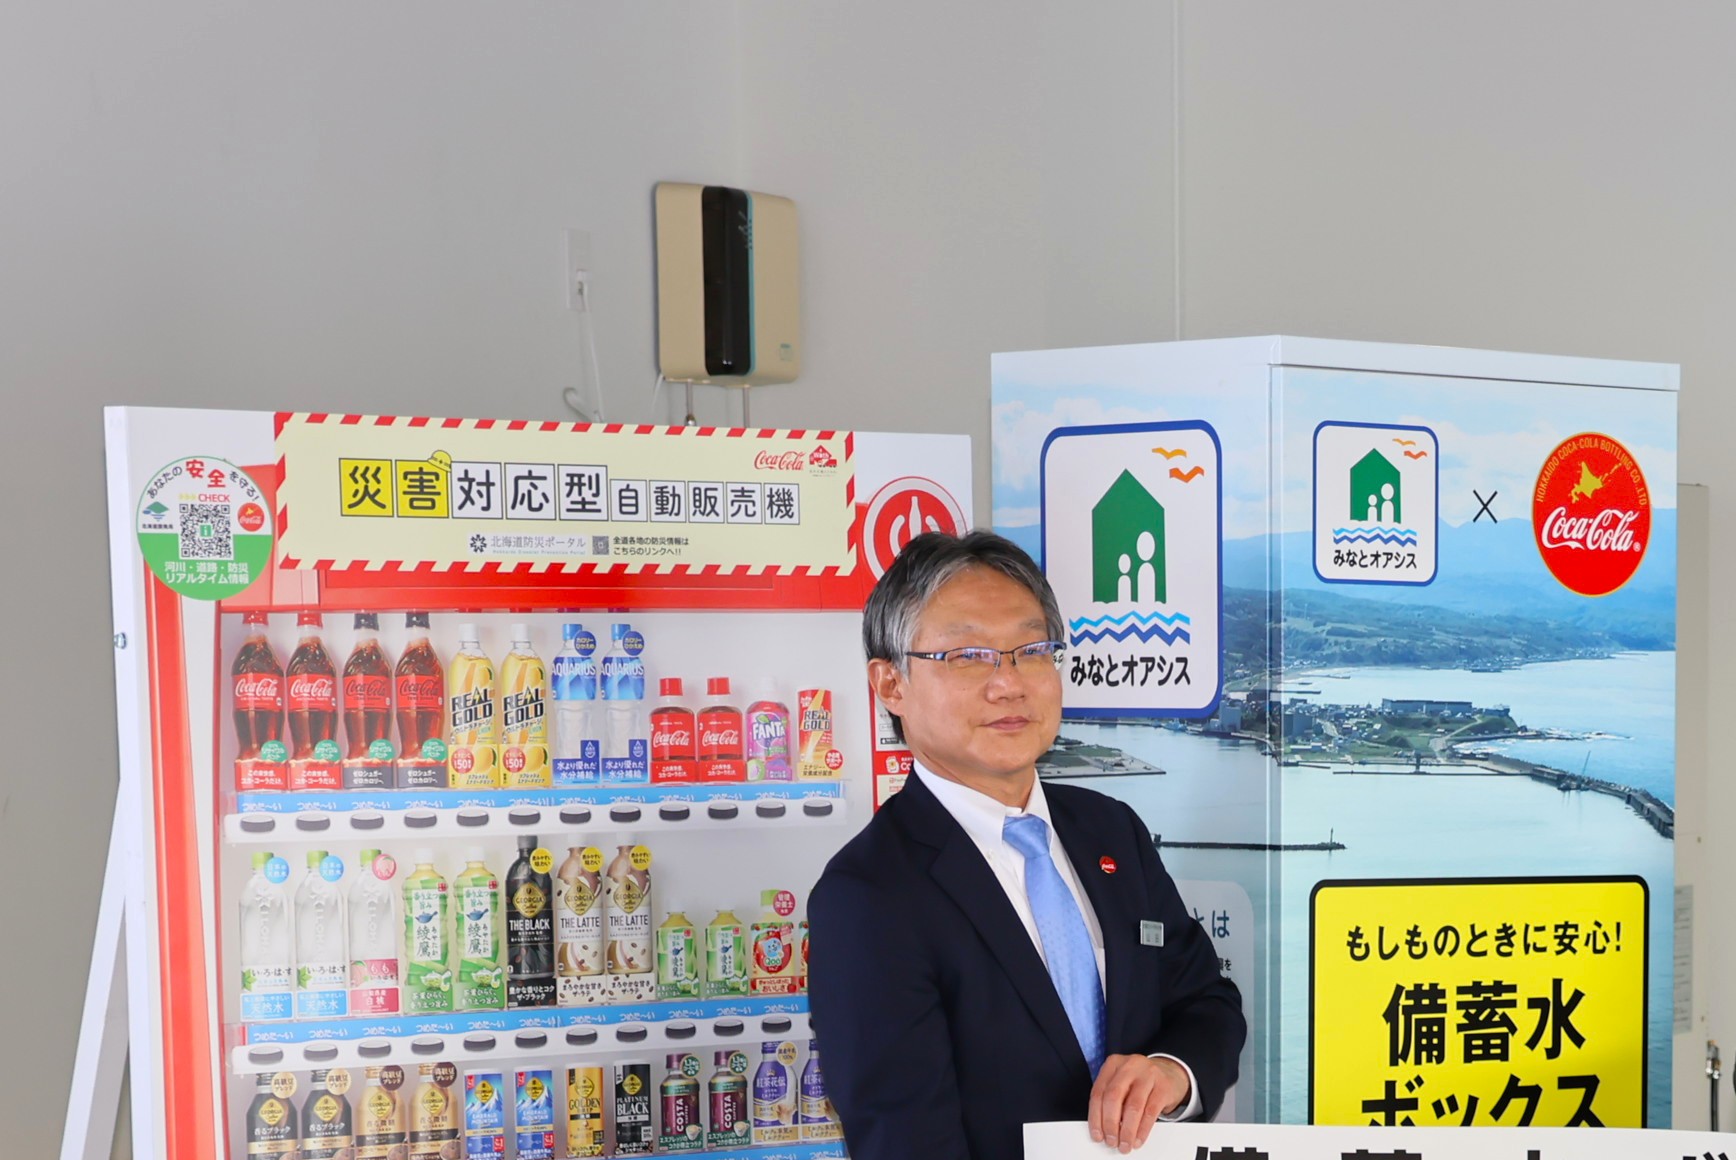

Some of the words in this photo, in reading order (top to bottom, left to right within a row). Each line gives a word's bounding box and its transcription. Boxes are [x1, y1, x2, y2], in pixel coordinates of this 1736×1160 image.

[754, 450, 804, 470] Coca-Cola
[1536, 458, 1559, 502] HOKKAIDO
[1558, 437, 1599, 460] COCA-COLA
[1600, 439, 1632, 471] BOTTLING
[198, 494, 230, 502] CHECK
[347, 466, 795, 519] 災害対応型自動販売機
[1542, 506, 1641, 552] Coca-Cola
[491, 536, 585, 548] 北海道防災ポータル
[613, 537, 689, 546] 全道各地の防災情報は
[1333, 549, 1418, 570] みなとオアシス
[166, 573, 249, 585] リアルタイム情報
[552, 663, 596, 676] AQUARIUS
[600, 663, 644, 676] AQUARIUS
[1070, 654, 1190, 687] みなとオアシス
[235, 679, 278, 697] Coca-Cola
[290, 679, 332, 697] Coca-Cola
[346, 680, 386, 696] Coca-Cola
[400, 680, 440, 696] Coca-Cola
[451, 687, 492, 711] REAL
[504, 686, 543, 711] REAL
[452, 703, 493, 727] GOLD
[504, 703, 544, 727] GOLD
[804, 709, 829, 720] REAL
[753, 721, 785, 740] FANTA
[803, 720, 830, 730] GOLD
[653, 730, 690, 747] Coca-Cola
[702, 730, 738, 747] Coca-Cola
[509, 920, 524, 931] THE
[525, 919, 550, 931] BLACK
[561, 917, 575, 928] THE
[576, 916, 600, 928] LATTE
[610, 916, 624, 926] THE
[625, 915, 649, 926] LATTE
[765, 956, 781, 966] Qoo
[1382, 978, 1586, 1066] 備蓄水
[569, 1098, 600, 1110] GOLDEN
[617, 1102, 649, 1115] BLACK
[1362, 1074, 1606, 1127] ボックス
[676, 1098, 684, 1131] COSTA
[724, 1095, 732, 1128] COSTA
